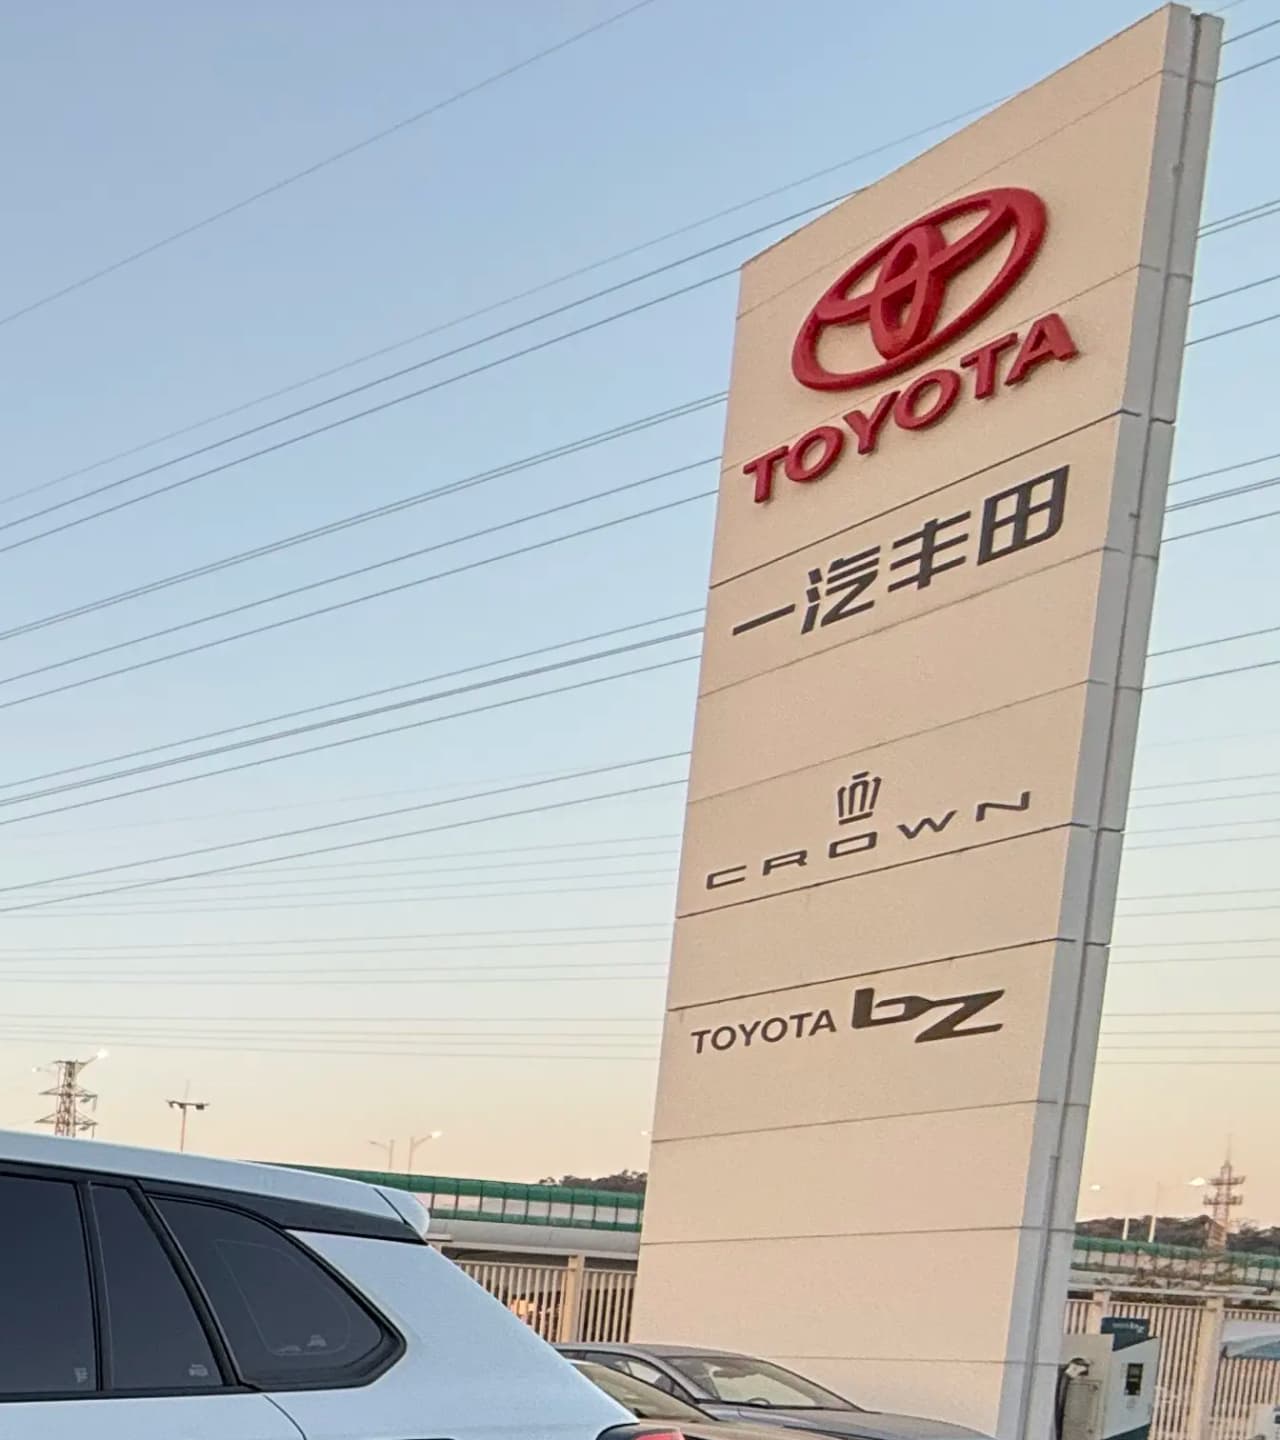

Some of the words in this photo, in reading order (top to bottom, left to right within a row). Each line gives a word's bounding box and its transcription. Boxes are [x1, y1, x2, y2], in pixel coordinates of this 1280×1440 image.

[742, 312, 1080, 505] TOYOTA
[732, 464, 1071, 636] 一汽丰田
[705, 791, 1031, 890] CROWN
[690, 1008, 838, 1055] TOYOTA
